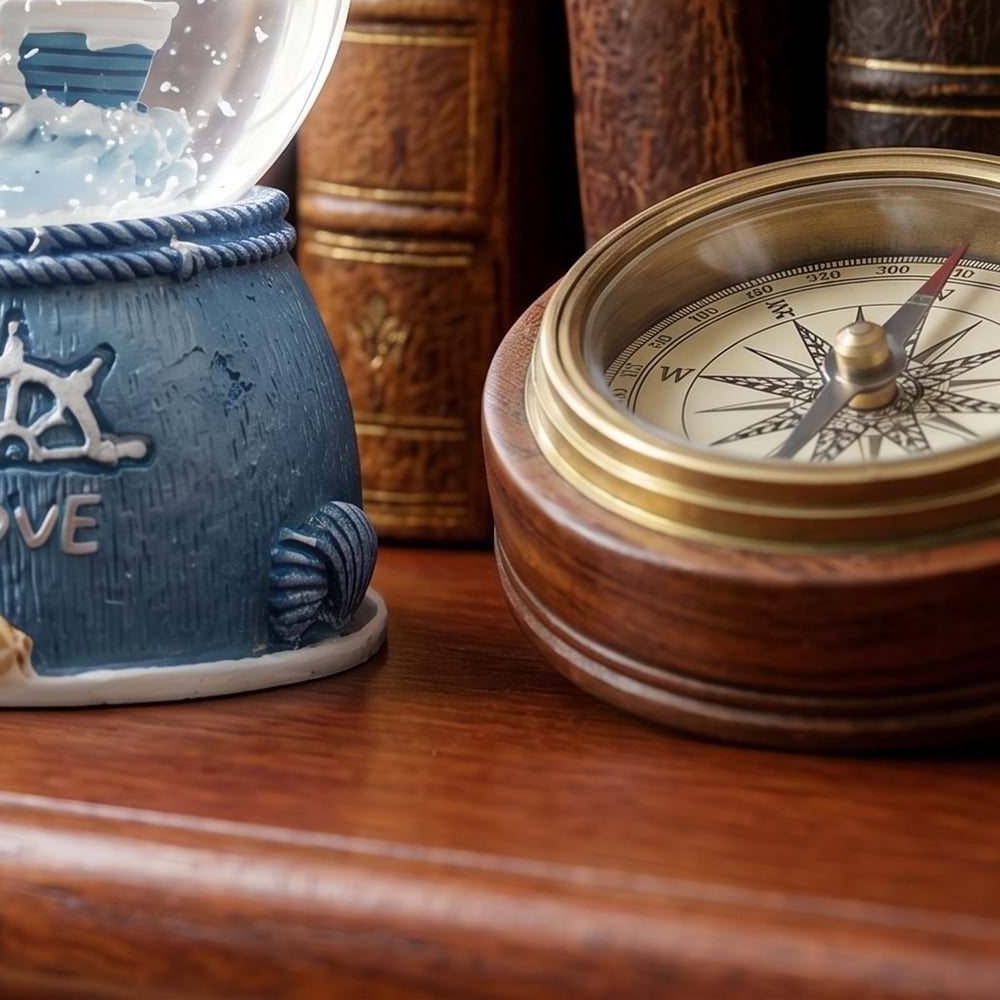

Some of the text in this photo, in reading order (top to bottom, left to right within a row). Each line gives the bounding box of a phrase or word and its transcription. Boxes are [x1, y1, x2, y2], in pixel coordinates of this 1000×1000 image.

[806, 270, 841, 283] 320
[876, 265, 910, 275] 300
[660, 365, 696, 383] W
